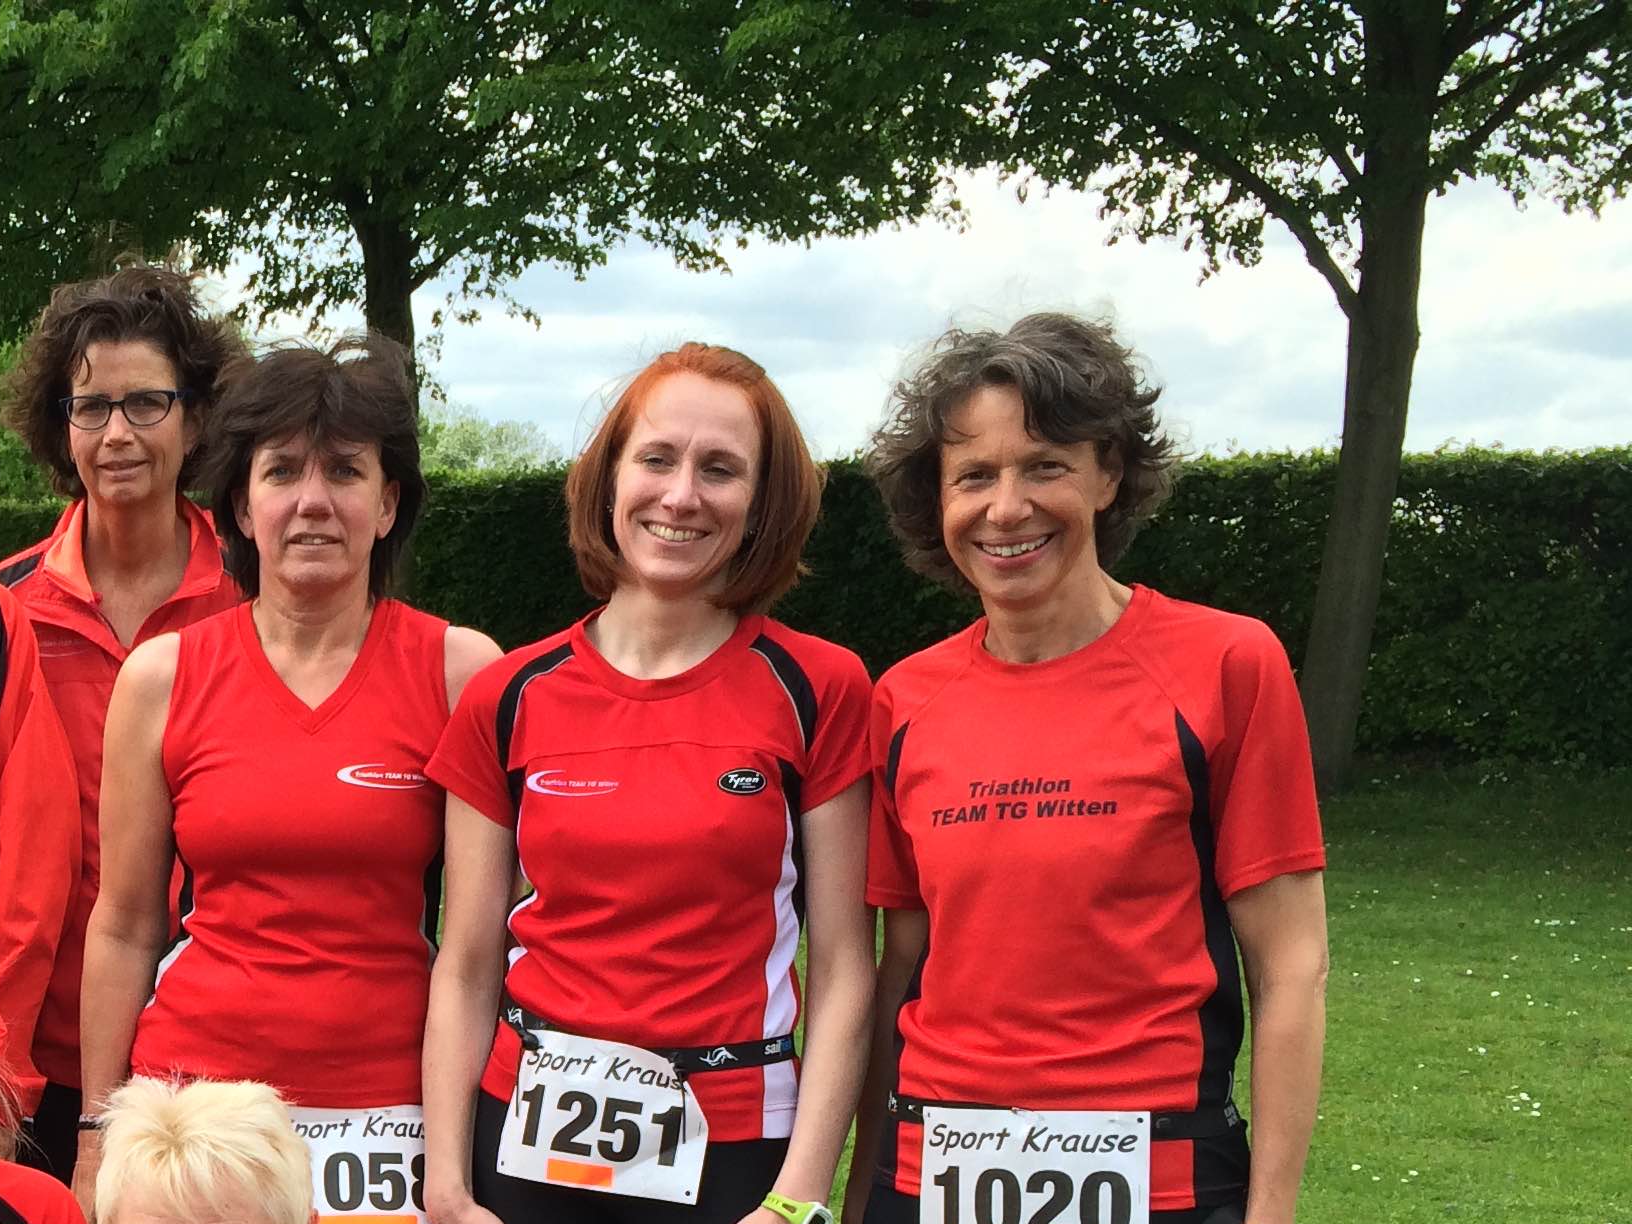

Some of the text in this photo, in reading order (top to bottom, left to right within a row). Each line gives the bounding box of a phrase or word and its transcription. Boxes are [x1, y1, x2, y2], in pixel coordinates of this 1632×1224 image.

[969, 777, 1071, 799] Triathlon
[931, 800, 1117, 827] TEAM TG Witten
[605, 1057, 686, 1091] Kraus
[521, 1083, 684, 1167] 1251
[929, 1123, 1138, 1156] Sport Krause
